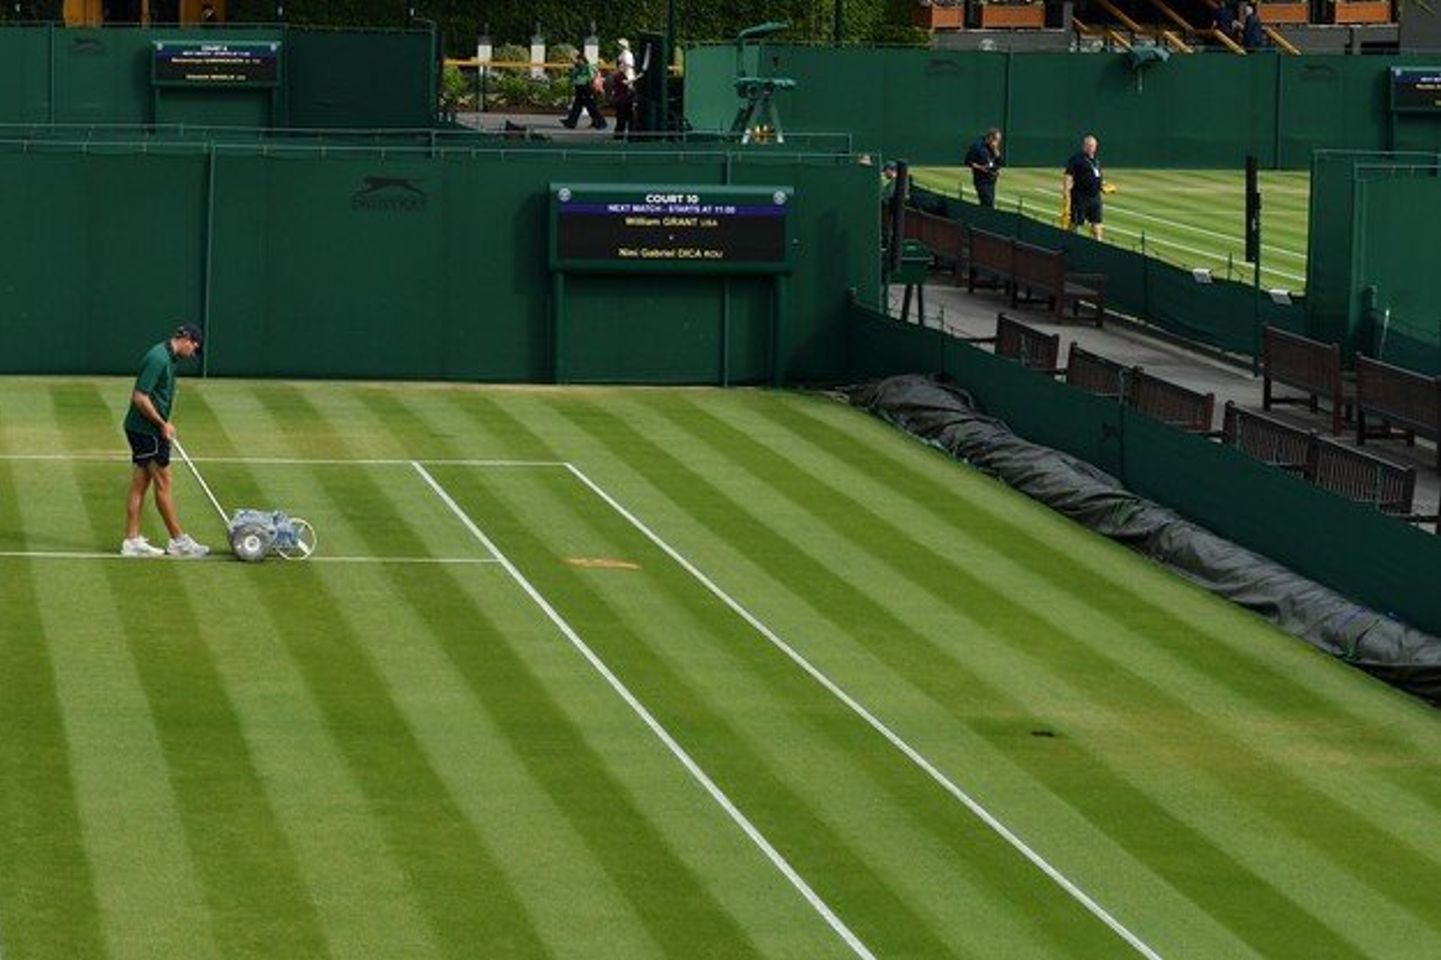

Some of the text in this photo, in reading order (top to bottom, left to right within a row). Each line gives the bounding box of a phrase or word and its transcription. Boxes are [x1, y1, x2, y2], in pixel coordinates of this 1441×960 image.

[645, 194, 700, 204] COURT 10
[608, 204, 631, 213] NEXT
[632, 204, 661, 213] MATCH
[669, 205, 700, 213] STARTS
[702, 205, 712, 213] AT
[625, 217, 719, 227] William GRANT USA
[640, 248, 677, 258] Gabriel
[678, 248, 702, 258] DICA
